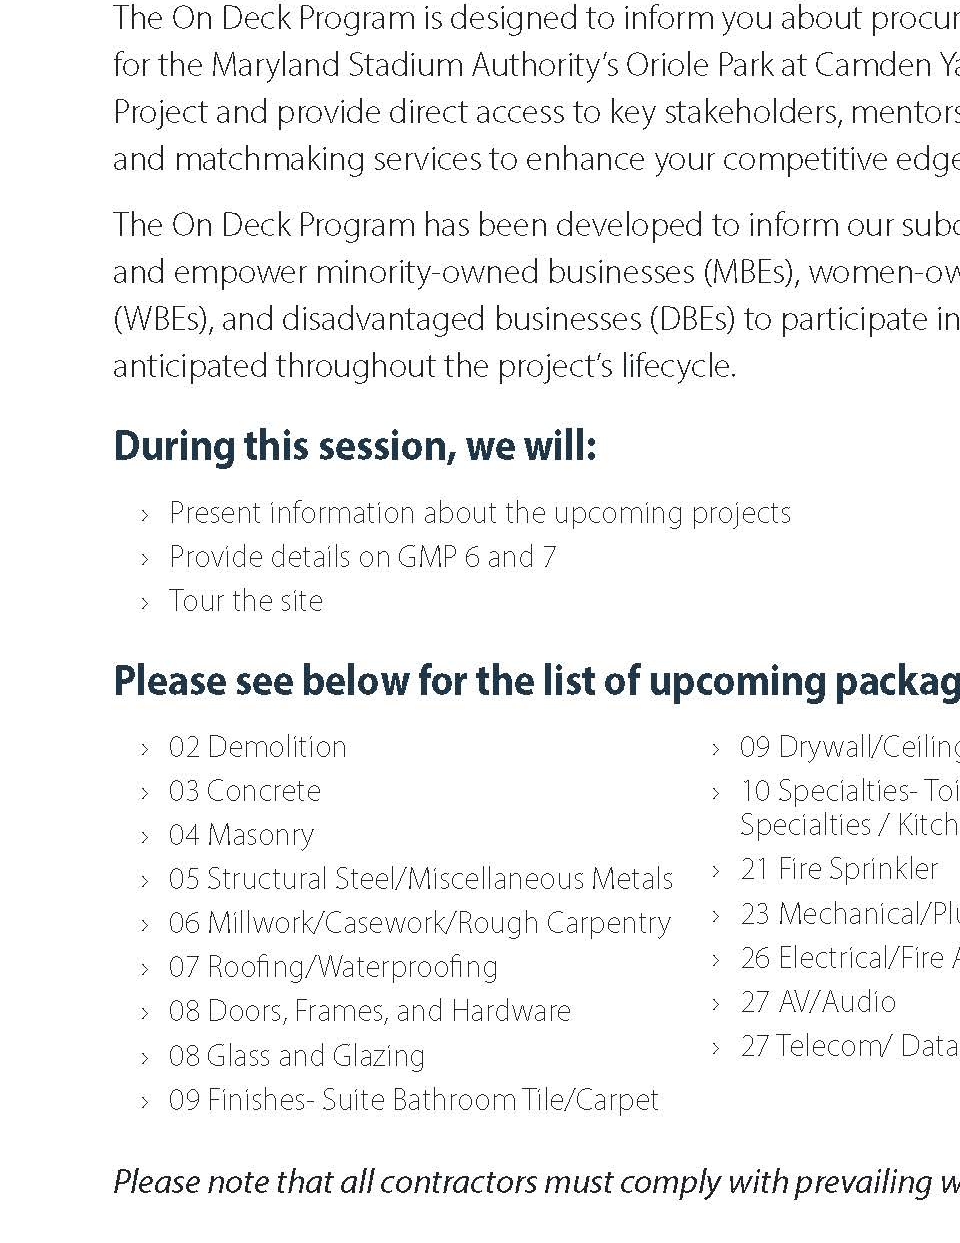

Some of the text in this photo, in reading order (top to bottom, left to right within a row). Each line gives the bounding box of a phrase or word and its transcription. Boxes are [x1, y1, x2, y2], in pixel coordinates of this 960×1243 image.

[114, 51, 150, 76] for
[158, 51, 202, 76] the
[213, 51, 338, 83] Maryland
[350, 51, 462, 76] Stadium
[627, 51, 708, 76] Oriole
[720, 51, 774, 76] Park
[782, 54, 807, 76] at
[816, 51, 930, 76] Camden
[114, 258, 163, 283] and
[175, 266, 307, 290] empower
[318, 258, 537, 290] minority-owned
[550, 258, 694, 283] businesses
[705, 259, 799, 288] (MBEs),
[114, 352, 266, 384] anticipated
[276, 352, 436, 384] throughout
[444, 352, 488, 377] the
[624, 352, 735, 384] lifecycle.
[116, 428, 595, 469] During this session, we will:
[172, 544, 556, 567] Provide details on GMP 6 and 7
[169, 588, 322, 611] Tour the site
[116, 663, 226, 695] Please
[237, 673, 293, 695] see
[304, 663, 410, 695] below
[419, 663, 467, 695] for
[476, 663, 534, 695] the
[545, 663, 595, 695] list
[605, 663, 641, 695] of
[651, 664, 825, 704] upcoming
[170, 734, 345, 757] 02 Demolition
[741, 736, 769, 757] 09
[170, 779, 320, 801] 03 Concrete
[170, 823, 314, 851] 04 Masonry
[742, 856, 938, 885] 21 Fire Sprinkler
[742, 903, 768, 924] 23
[170, 954, 496, 983] 07 Roofing/Waterproofing
[742, 989, 895, 1013] 27 AV/Audio
[114, 1168, 200, 1193] Please
[208, 1172, 269, 1193] note
[278, 1168, 334, 1193] that
[341, 1168, 375, 1193] all
[381, 1172, 537, 1193] contractors
[545, 1172, 614, 1193] must
[621, 1168, 722, 1200] comply
[730, 1168, 788, 1193] with
[794, 1168, 932, 1200] prevailing
